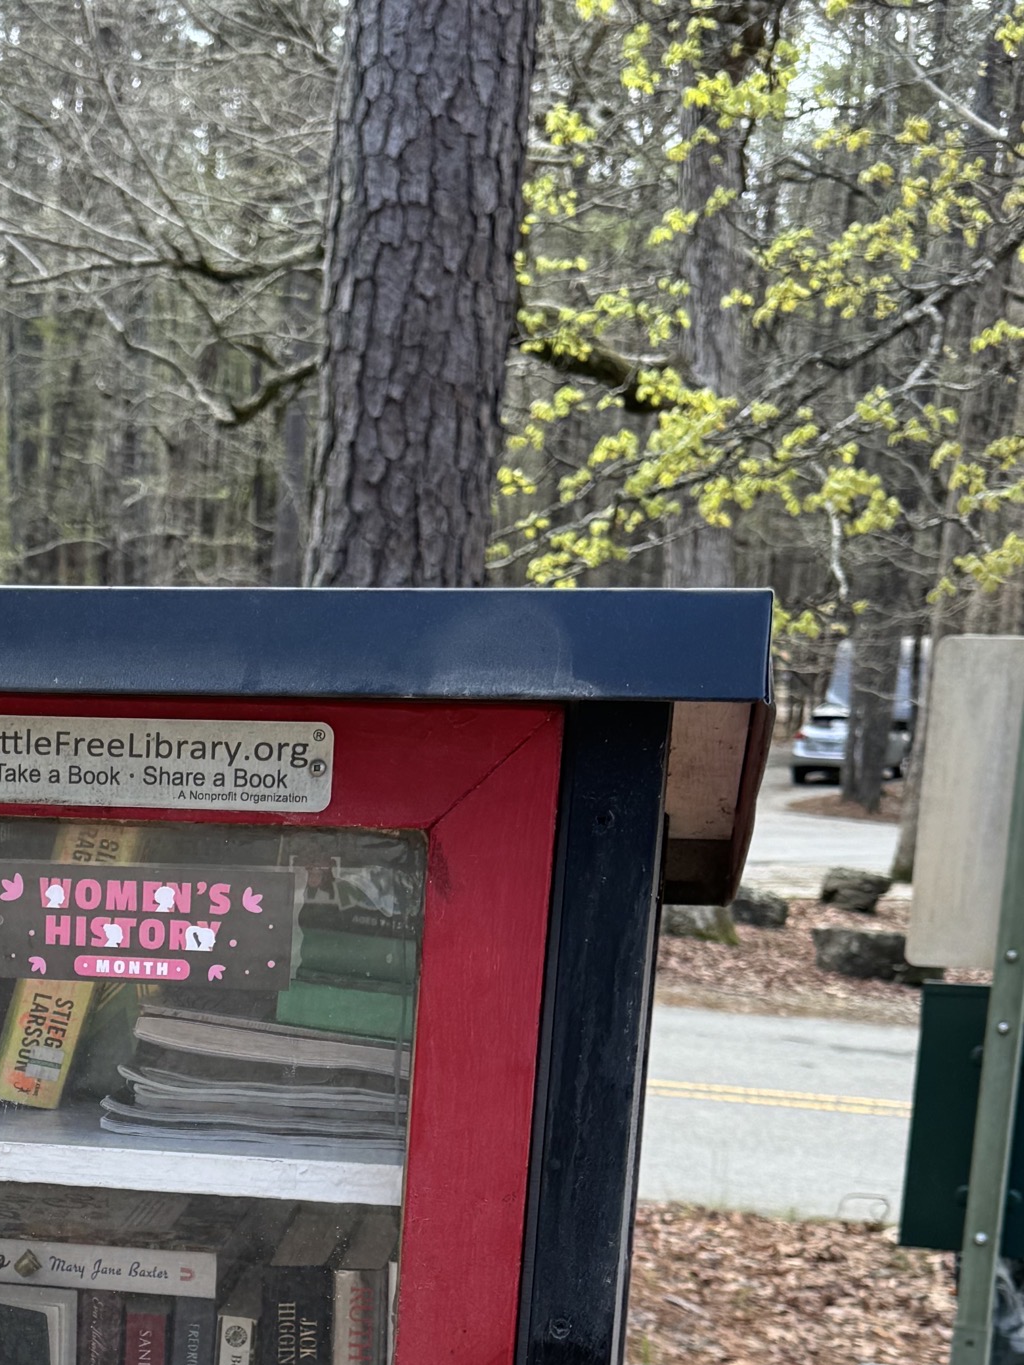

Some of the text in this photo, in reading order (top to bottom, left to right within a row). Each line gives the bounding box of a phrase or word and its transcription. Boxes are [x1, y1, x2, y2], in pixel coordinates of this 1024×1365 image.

[48, 768, 60, 784] a
[68, 766, 121, 786] Book
[142, 765, 206, 788] Share
[212, 771, 225, 787] a
[233, 768, 288, 788] Book
[177, 790, 308, 804] A Nonprofit Organization
[39, 877, 232, 915] WOMEN'S
[95, 958, 169, 976] MONTH
[14, 993, 52, 1073] LARSSON
[43, 997, 74, 1050] STIEG
[49, 1256, 170, 1281] Mary Jane Baxter
[299, 1317, 318, 1361] JACK
[347, 1286, 374, 1362] RUTH
